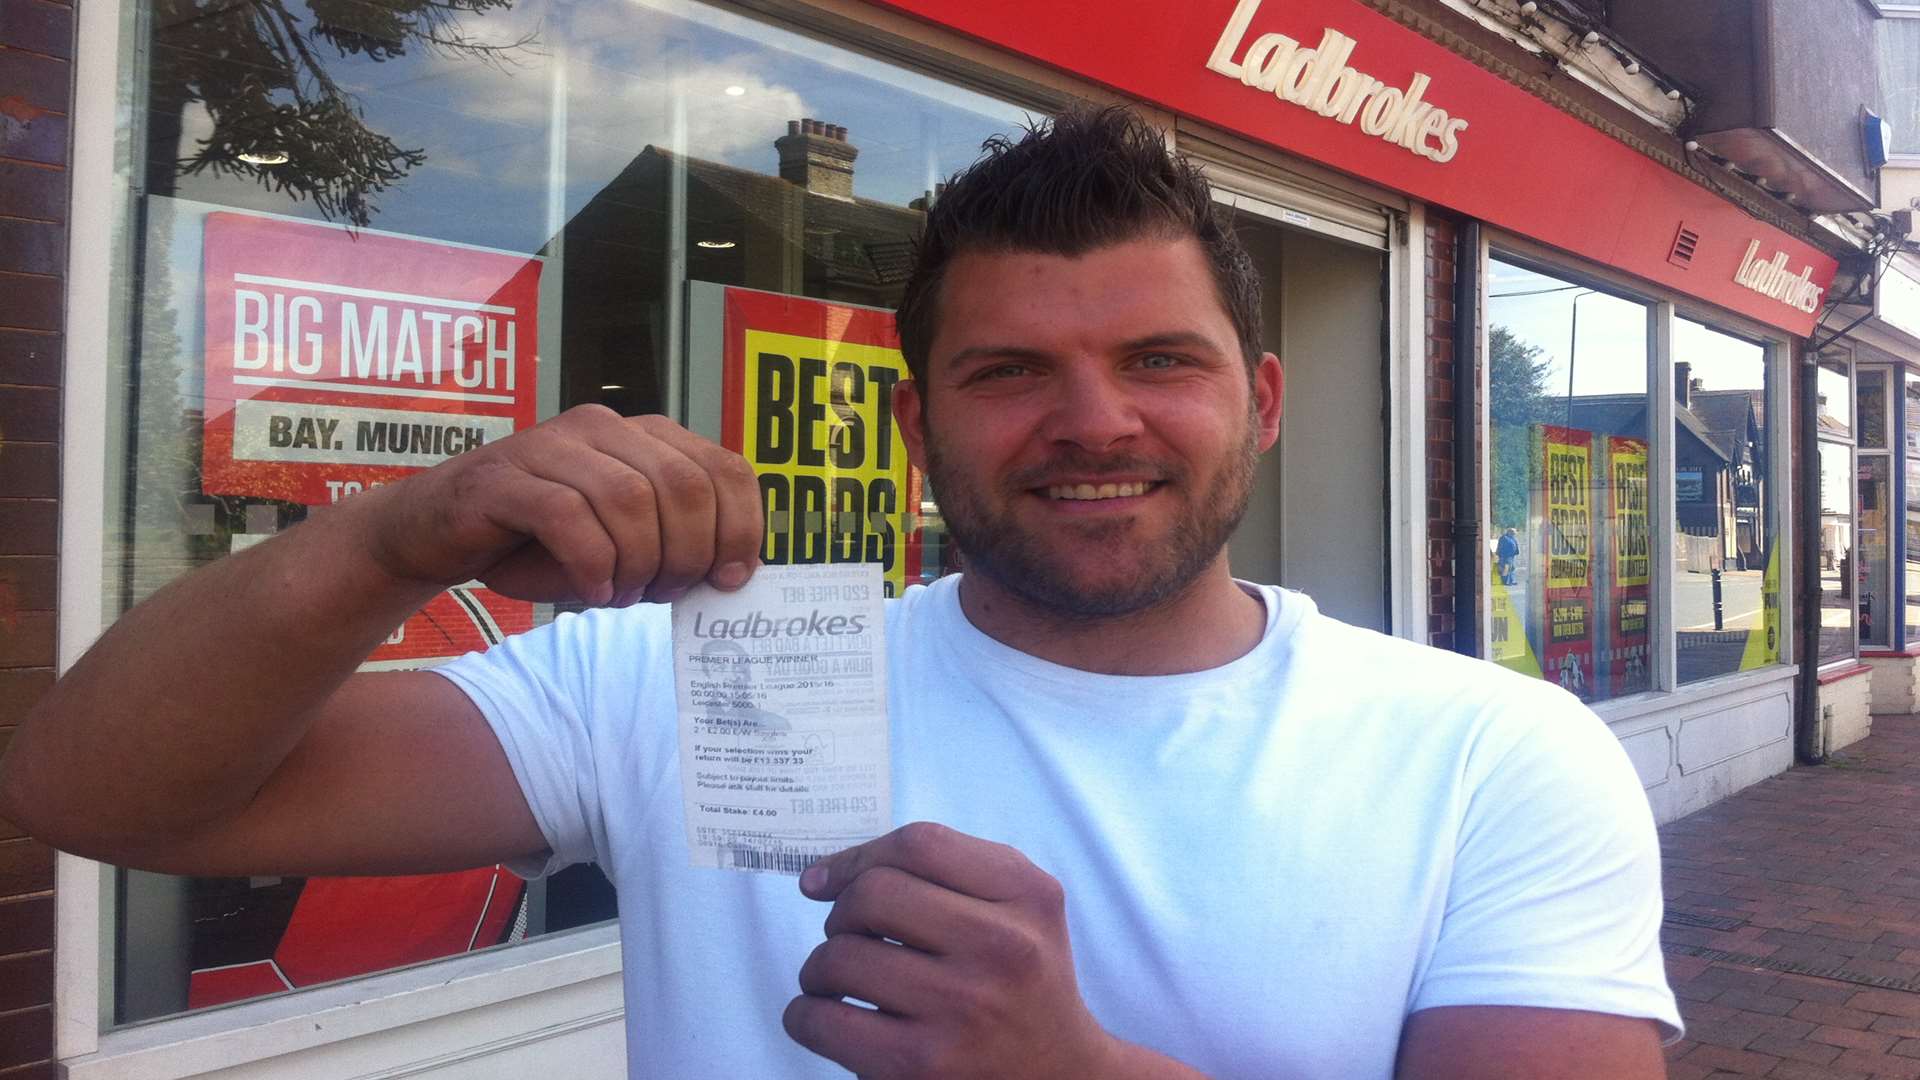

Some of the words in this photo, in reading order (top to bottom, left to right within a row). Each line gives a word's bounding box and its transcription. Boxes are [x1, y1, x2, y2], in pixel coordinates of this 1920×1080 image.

[1206, 0, 1468, 164] Ladbrokes
[1734, 239, 1824, 315] Ladbrokes
[233, 289, 322, 375] BIG
[341, 302, 516, 390] MATCH
[755, 352, 899, 471] BEST
[269, 415, 343, 452] BAY.
[356, 421, 485, 457] MUNICH
[1550, 453, 1585, 506] BEST
[760, 473, 897, 573] ODDS
[693, 609, 868, 640] Ladbrokes
[688, 655, 730, 665] PREMIER
[732, 655, 773, 665] LEAGUE
[776, 655, 818, 664] WINNER
[690, 680, 720, 690] English
[694, 717, 714, 725] Your
[716, 718, 741, 727] Bet(s)
[702, 746, 722, 754] your
[724, 747, 765, 755] selection
[791, 749, 813, 757] your
[741, 757, 753, 765] be
[697, 781, 727, 789] Please
[700, 805, 720, 813] Total
[723, 806, 749, 815] Stake:
[752, 809, 778, 817] £4.00
